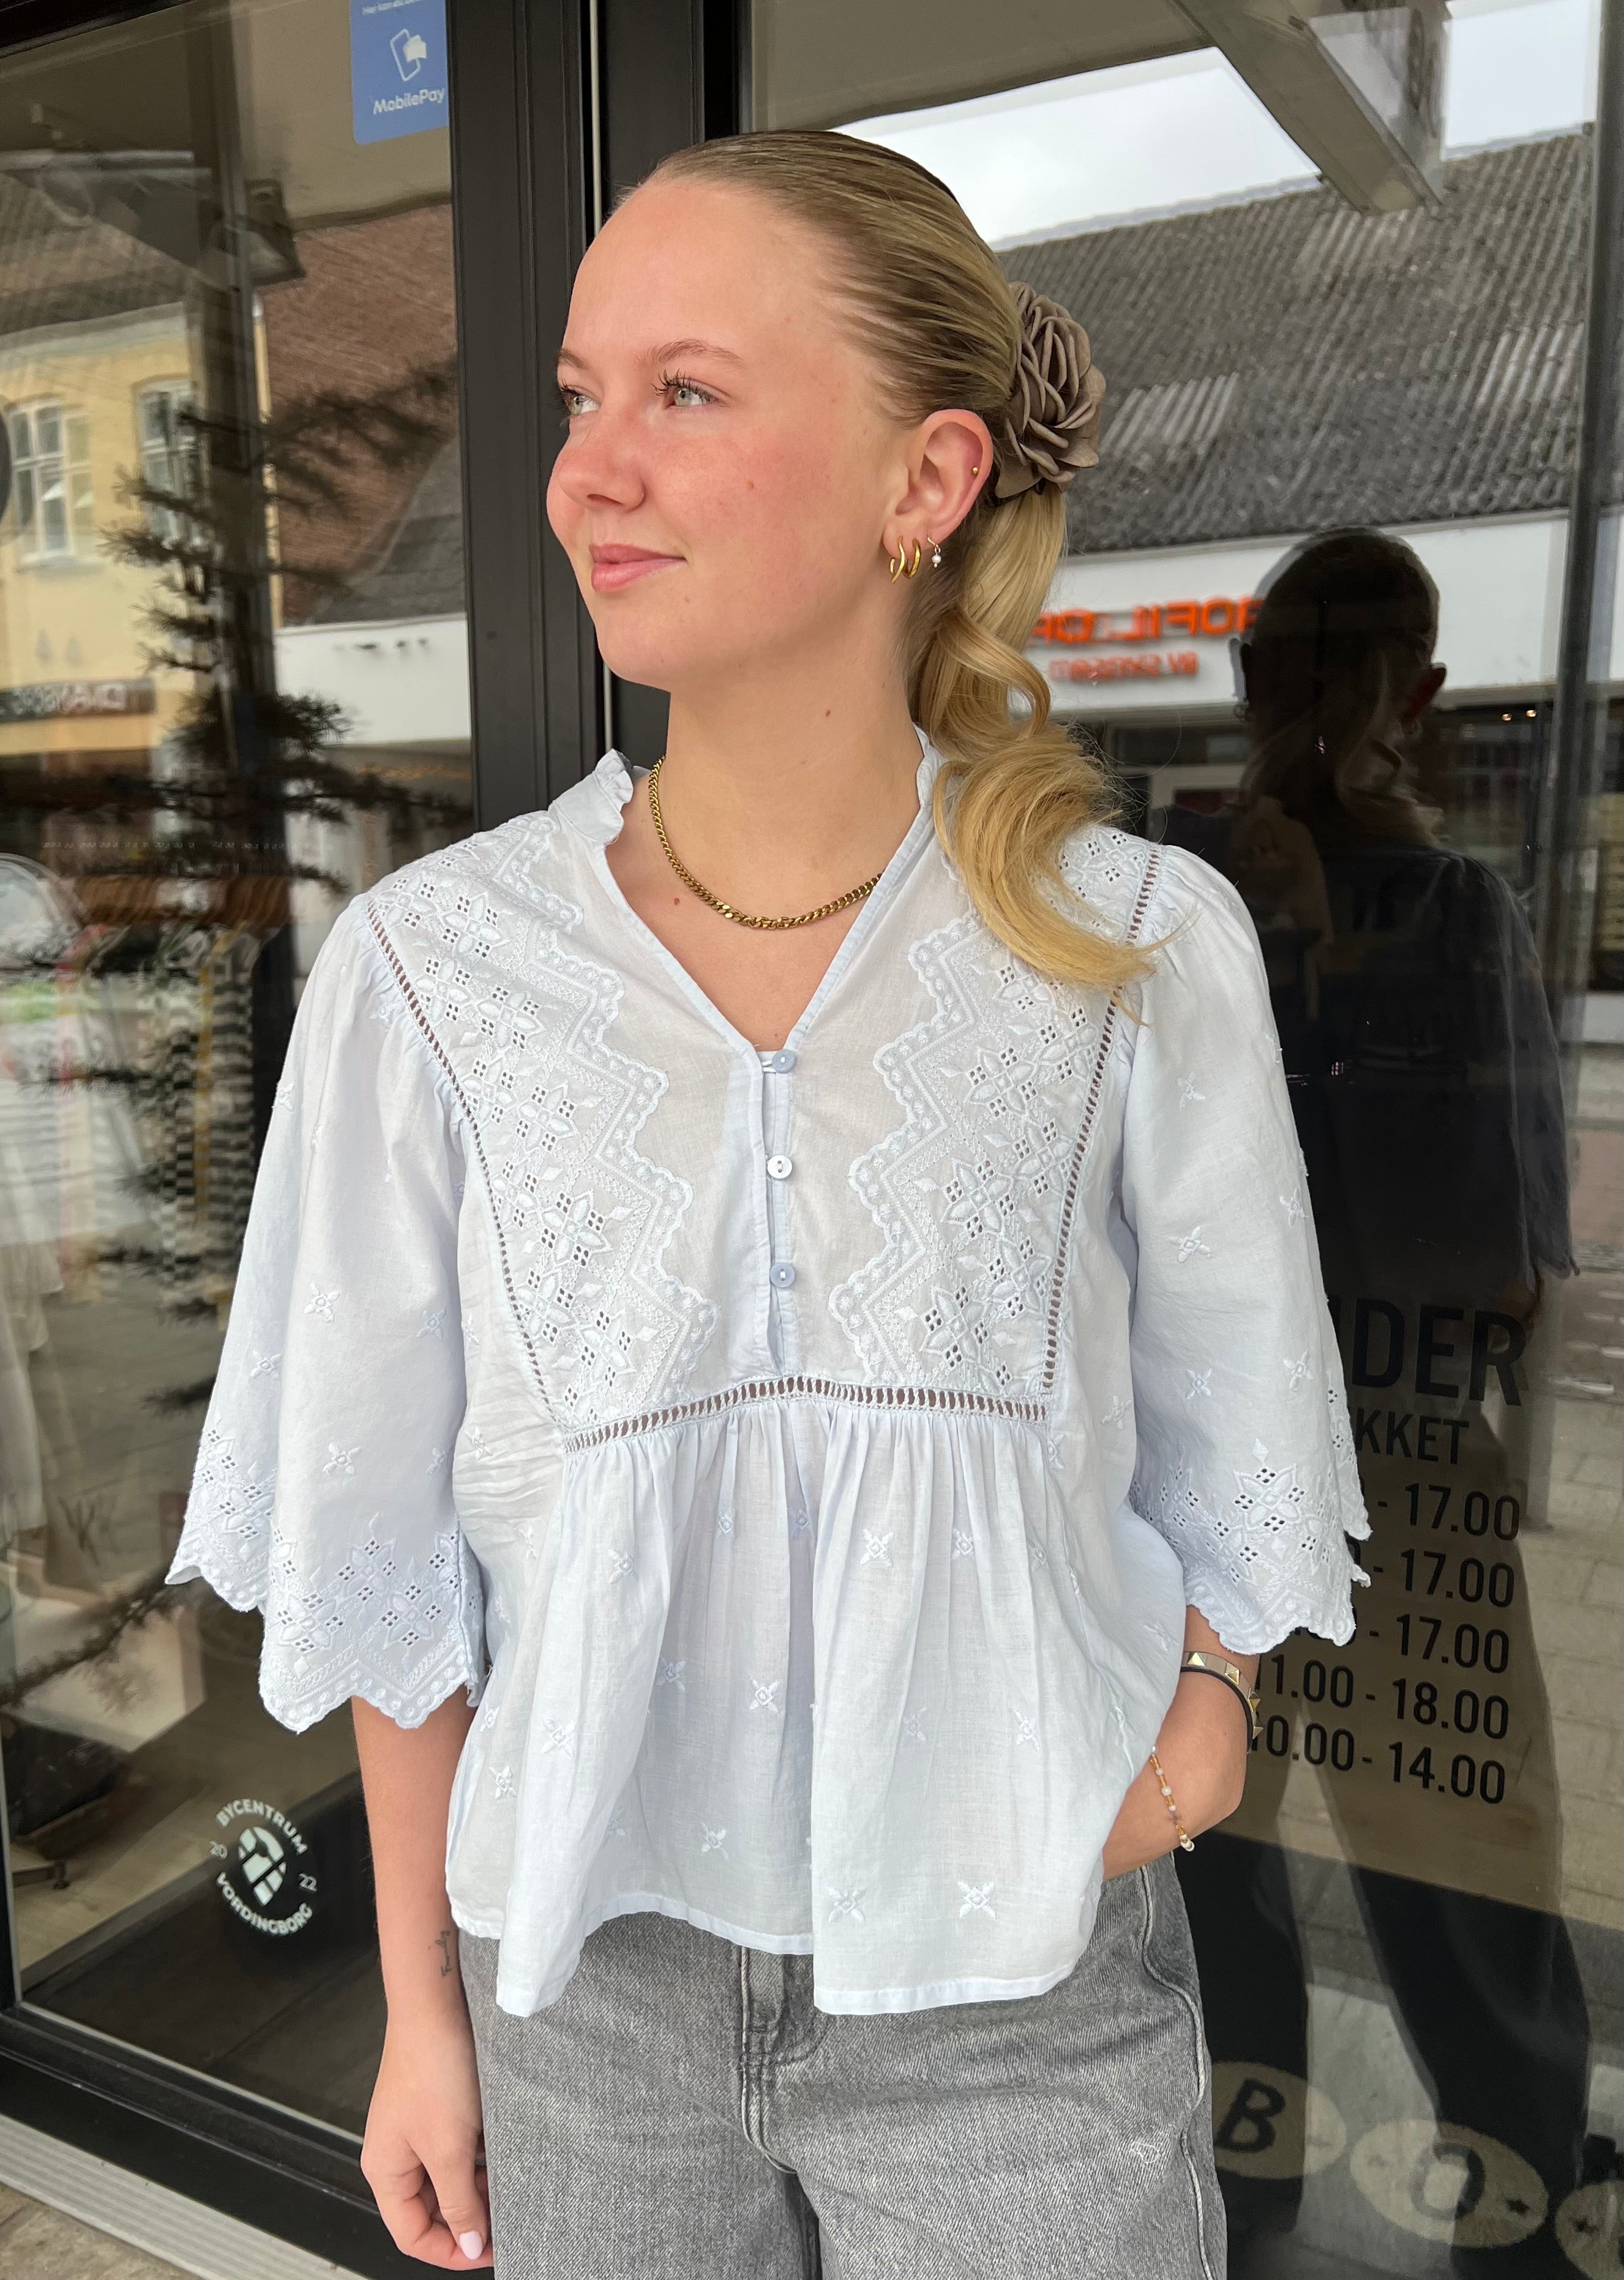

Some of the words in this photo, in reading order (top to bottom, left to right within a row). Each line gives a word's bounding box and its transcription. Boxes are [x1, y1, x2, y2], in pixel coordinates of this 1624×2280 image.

[373, 89, 446, 114] MobilePay
[1405, 1483, 1520, 1541] 17.00
[1401, 1548, 1515, 1608] 17.00
[1396, 1613, 1510, 1673] 17.00
[1392, 1678, 1509, 1739] 18.00
[1389, 1741, 1505, 1804] 14.00
[209, 1841, 228, 1859] 20
[216, 1799, 308, 1855] BYCENTRUM
[216, 1871, 313, 1935] VORDINGBORG
[299, 1872, 318, 1892] 22
